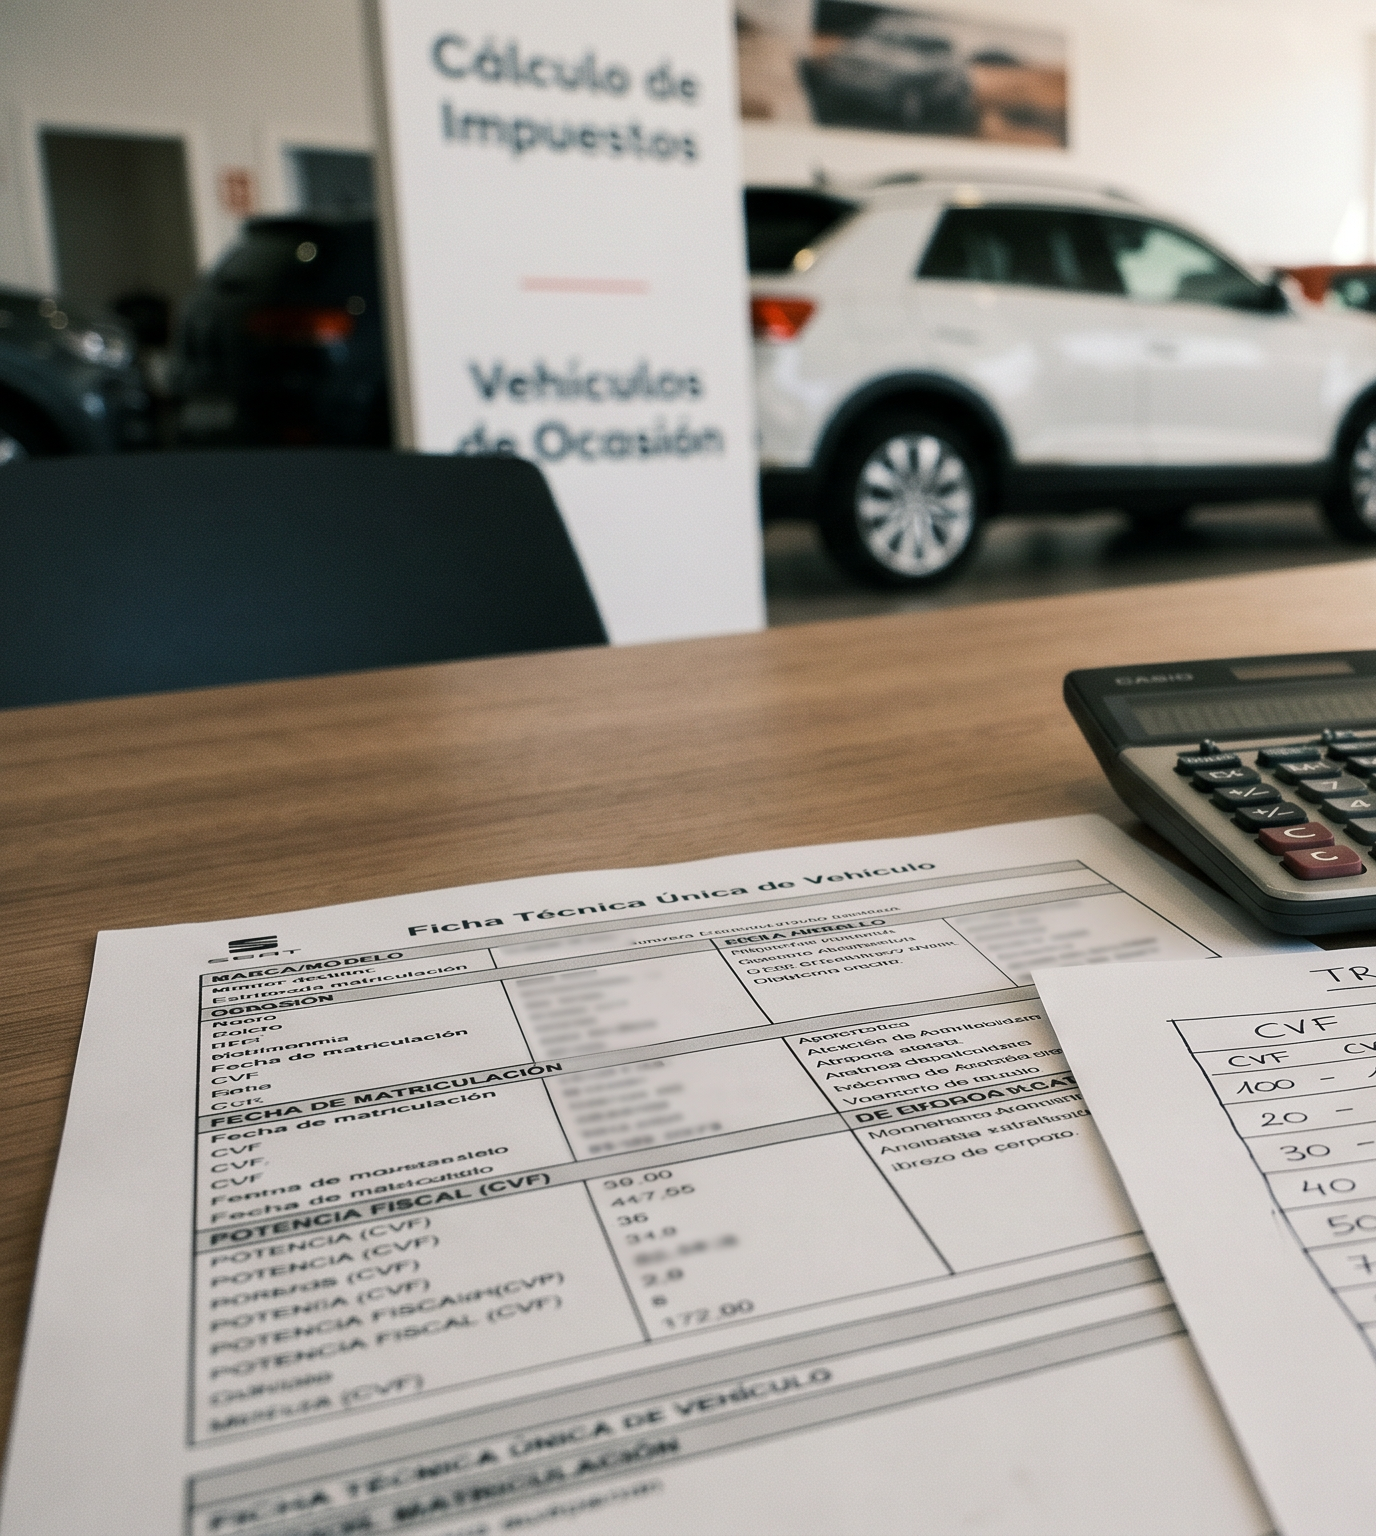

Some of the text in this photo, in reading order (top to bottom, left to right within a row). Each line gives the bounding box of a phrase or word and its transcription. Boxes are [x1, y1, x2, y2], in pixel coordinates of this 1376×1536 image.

[431, 33, 698, 103] Cálculo de
[441, 98, 699, 162] Impuestos
[469, 358, 702, 402] Vehículos
[534, 413, 724, 462] Ocasión
[1350, 799, 1371, 809] 4
[1283, 827, 1316, 839] C
[407, 861, 937, 937] Ficha Técnica Única de Vehículo
[212, 952, 404, 983] MARCA/MODELO
[1254, 1015, 1338, 1039] CVF
[211, 1057, 281, 1073] Fecha
[322, 1029, 468, 1057] matriculación
[1228, 1050, 1290, 1067] CVF
[211, 1071, 260, 1085] CVF
[1236, 1079, 1296, 1095] 100
[211, 1061, 562, 1128] FECHA DE MATRICULACIÓN
[211, 1090, 497, 1143] Fecha de matriculación
[855, 1109, 893, 1123] DE
[1261, 1112, 1308, 1127] 20
[211, 1143, 263, 1158] CVF
[961, 1146, 988, 1158] de
[1280, 1144, 1331, 1161] 30
[211, 1173, 264, 1190] CVF
[309, 1175, 342, 1189] de
[1302, 1177, 1356, 1196] 40
[210, 1193, 342, 1224] Fecha de
[210, 1209, 362, 1246] POTENCIA
[370, 1189, 473, 1216] FISCAL
[479, 1172, 552, 1199] (CVF)
[210, 1216, 431, 1267] POTENCIA (CVF)
[210, 1234, 440, 1288] POTENCIA (CVF)
[346, 1259, 421, 1286] (CVF)
[356, 1278, 431, 1305] (CVF)
[210, 1316, 363, 1357] POTENCIA
[210, 1294, 563, 1381] POTENCIA FISCAL (CVF)
[347, 1449, 498, 1498] TÉCNICA
[508, 1421, 613, 1458] ÚNICA
[622, 1409, 664, 1430] DE
[674, 1367, 834, 1417] VEHÍCULO
